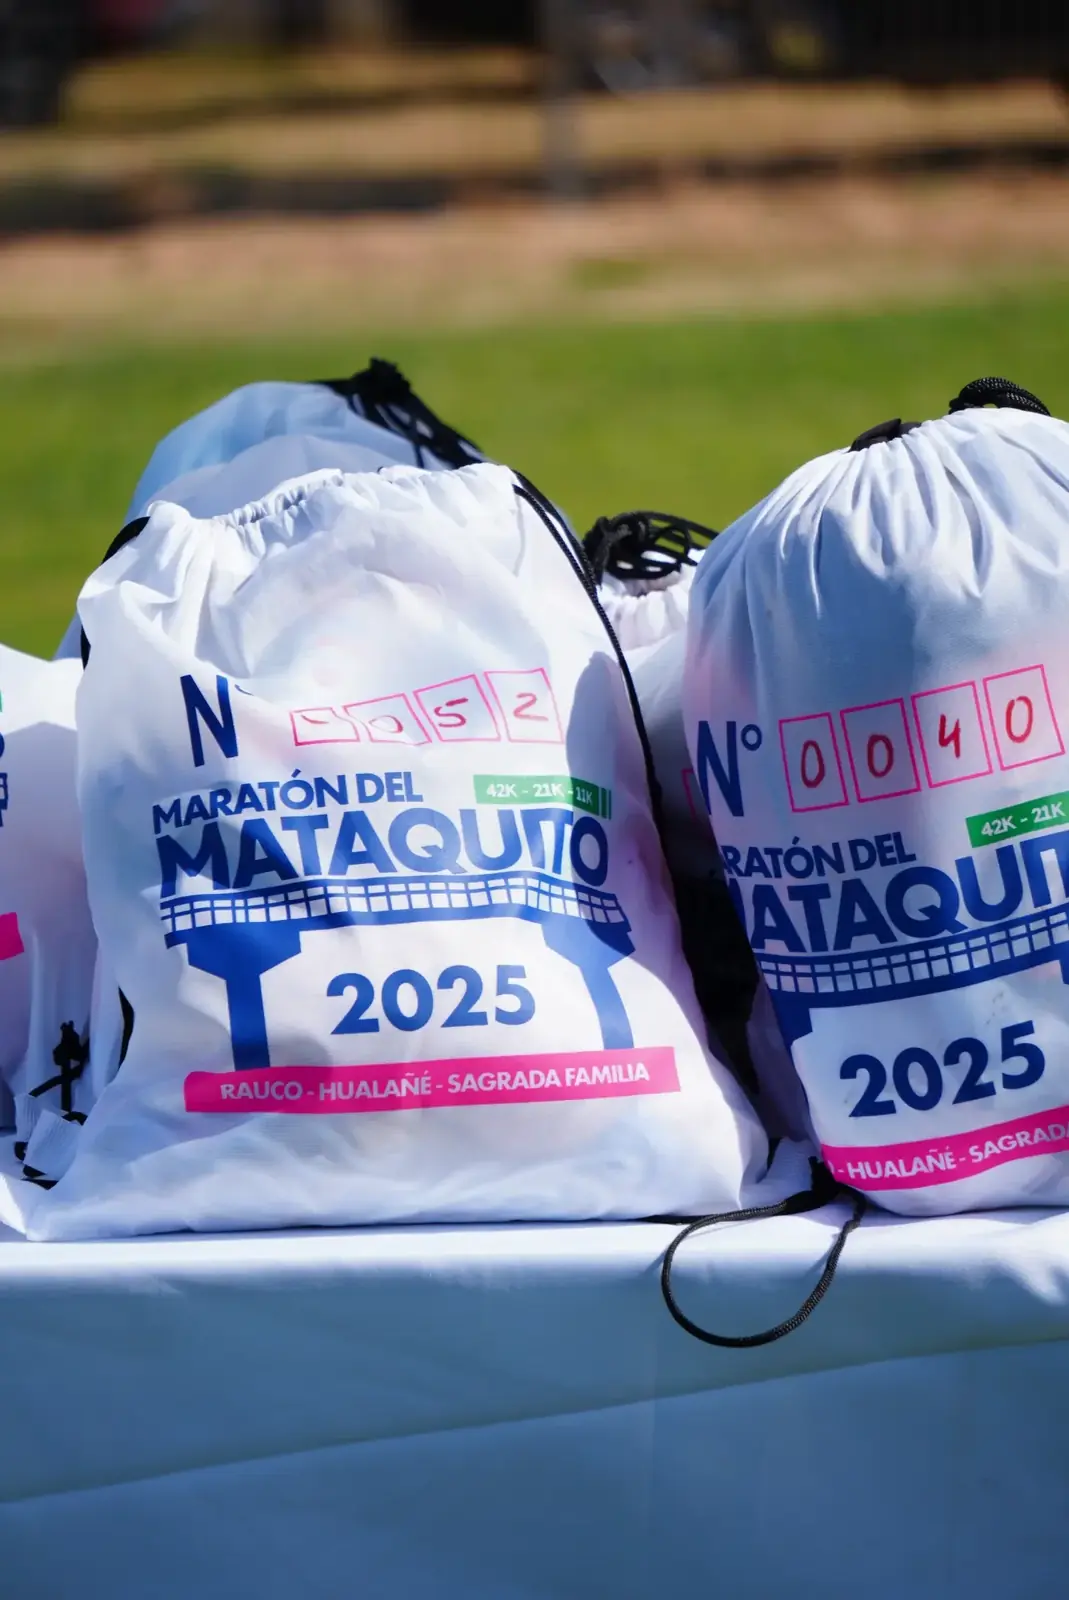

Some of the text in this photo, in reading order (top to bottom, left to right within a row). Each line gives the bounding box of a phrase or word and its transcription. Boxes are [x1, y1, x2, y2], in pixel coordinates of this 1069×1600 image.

[697, 721, 762, 817] N°
[801, 696, 1033, 788] 0040
[153, 769, 423, 834] MARATÓN DEL
[486, 783, 518, 798] 42K
[533, 783, 565, 798] 21K
[576, 786, 594, 805] 11K
[981, 815, 1017, 836] 42K
[1031, 802, 1066, 823] 21K
[156, 807, 609, 898] MATAQUITO
[720, 831, 917, 879] RATÓN DEL
[326, 964, 536, 1035] 2025
[220, 1081, 303, 1100] RAUCO
[319, 1070, 432, 1101] HUALAÑÉ
[447, 1069, 561, 1094] SAGRADA
[565, 1062, 650, 1086] FAMILIA
[839, 1020, 1046, 1118] 2025
[847, 1146, 957, 1179] HUALAÑÉ
[968, 1121, 1069, 1163] SAGRAD
